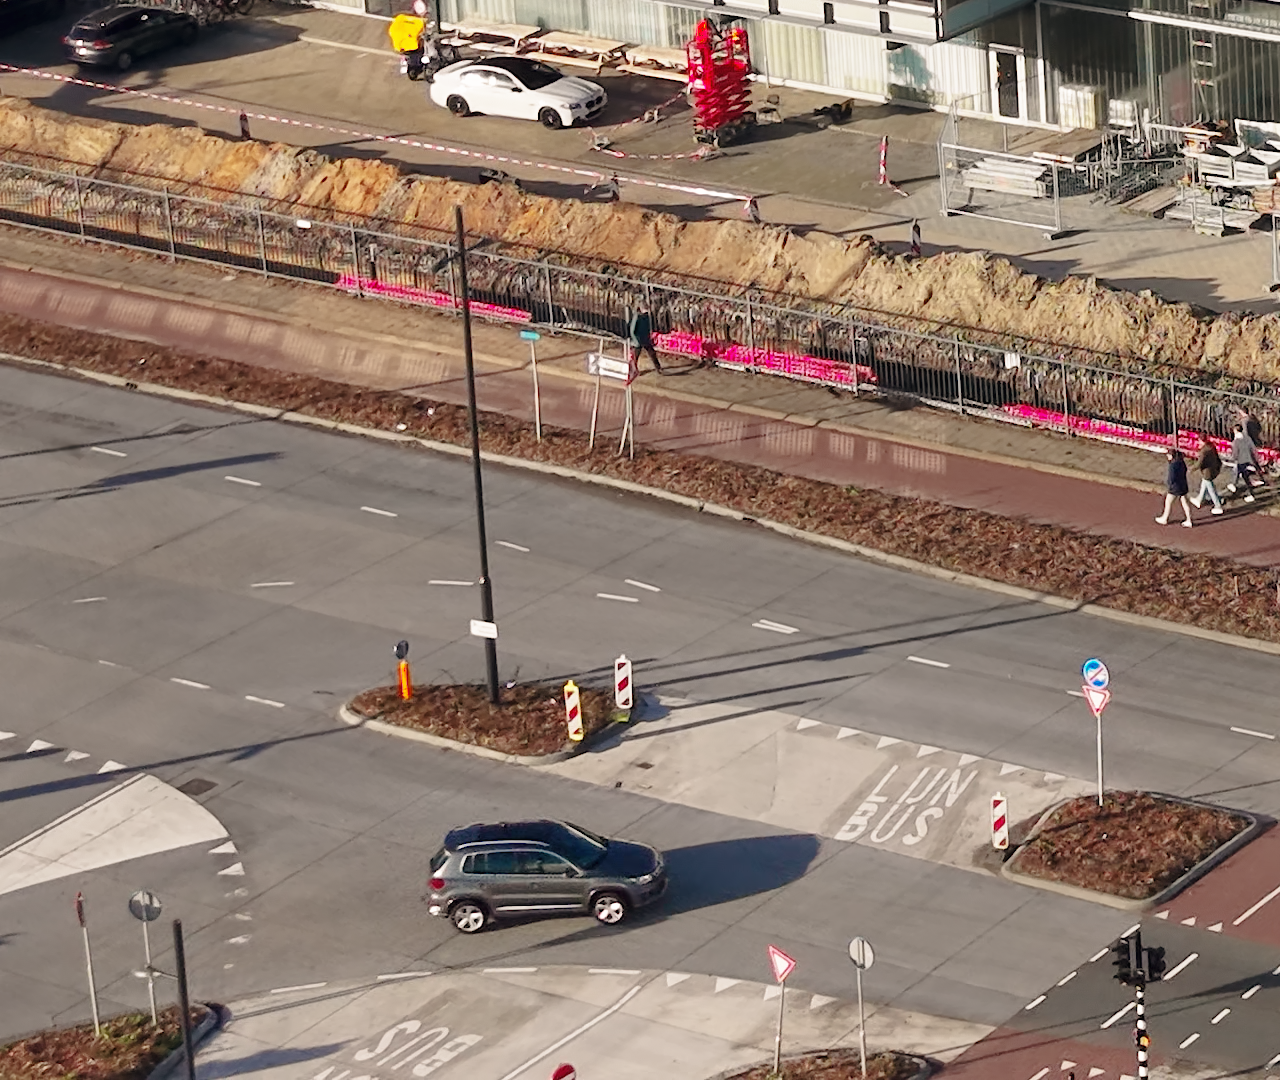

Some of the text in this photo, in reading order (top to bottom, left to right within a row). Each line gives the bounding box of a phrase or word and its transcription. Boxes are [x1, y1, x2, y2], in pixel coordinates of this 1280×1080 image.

[865, 763, 979, 808] LIJN
[834, 802, 944, 846] BUS
[353, 1020, 484, 1078] BUS
